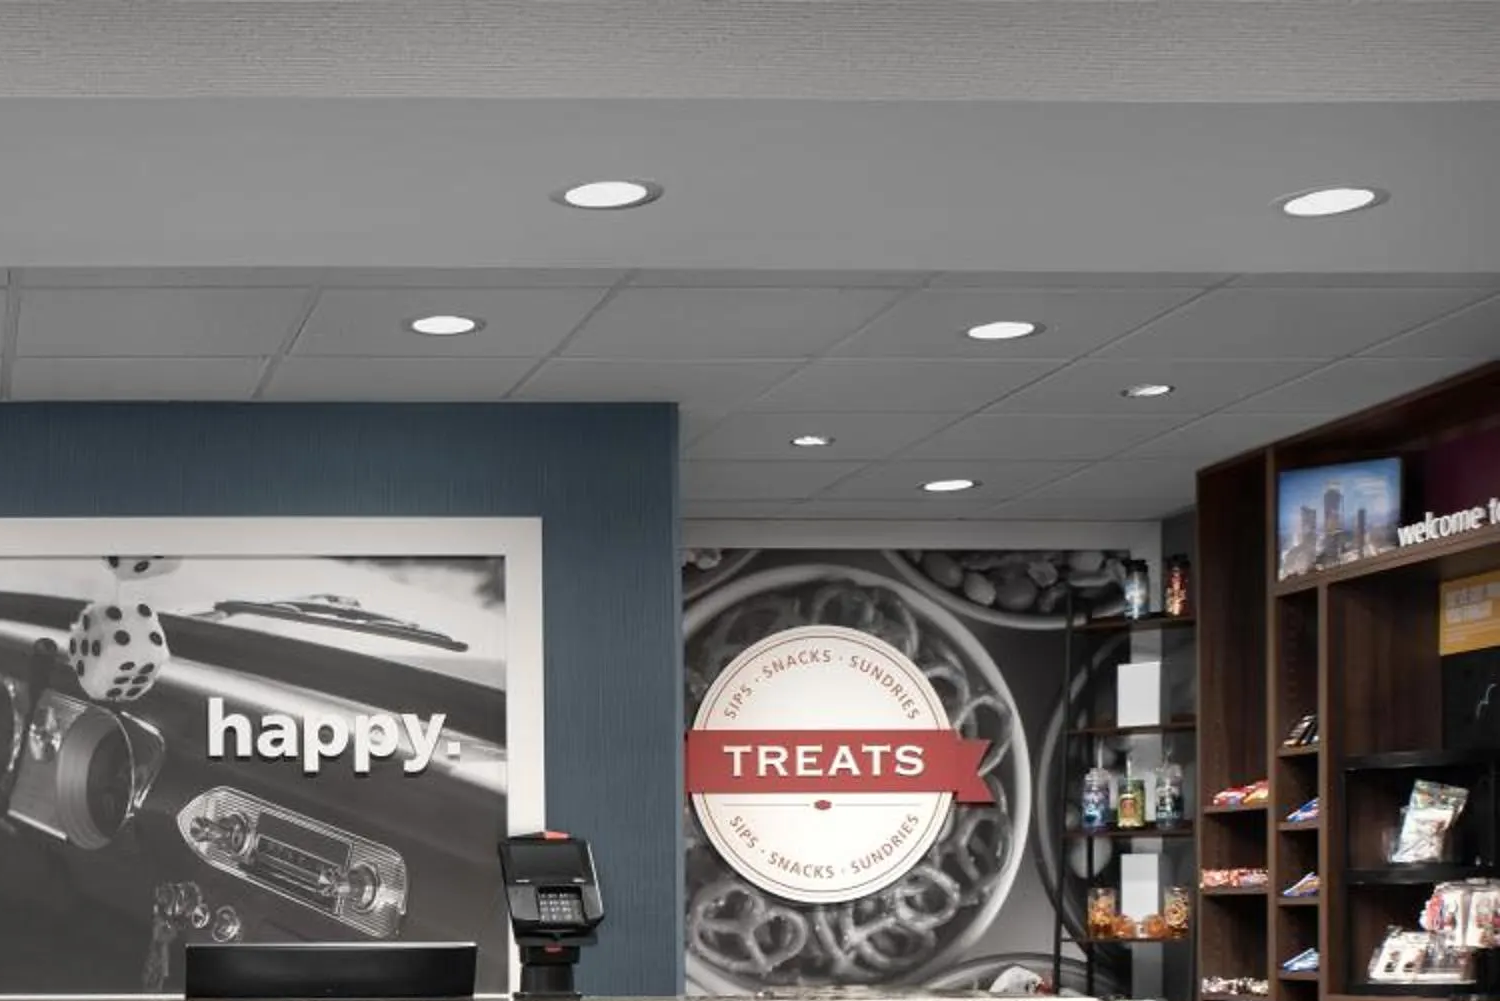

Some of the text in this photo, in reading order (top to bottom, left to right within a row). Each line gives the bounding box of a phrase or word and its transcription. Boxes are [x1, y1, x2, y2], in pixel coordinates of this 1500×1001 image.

[1398, 507, 1486, 547] welcome
[723, 649, 920, 720] SIPS SNACKS SUNDRIES
[208, 697, 461, 773] happy.
[723, 744, 925, 777] TREATS
[729, 813, 920, 880] SIPS SNACKS SUNDRIES
